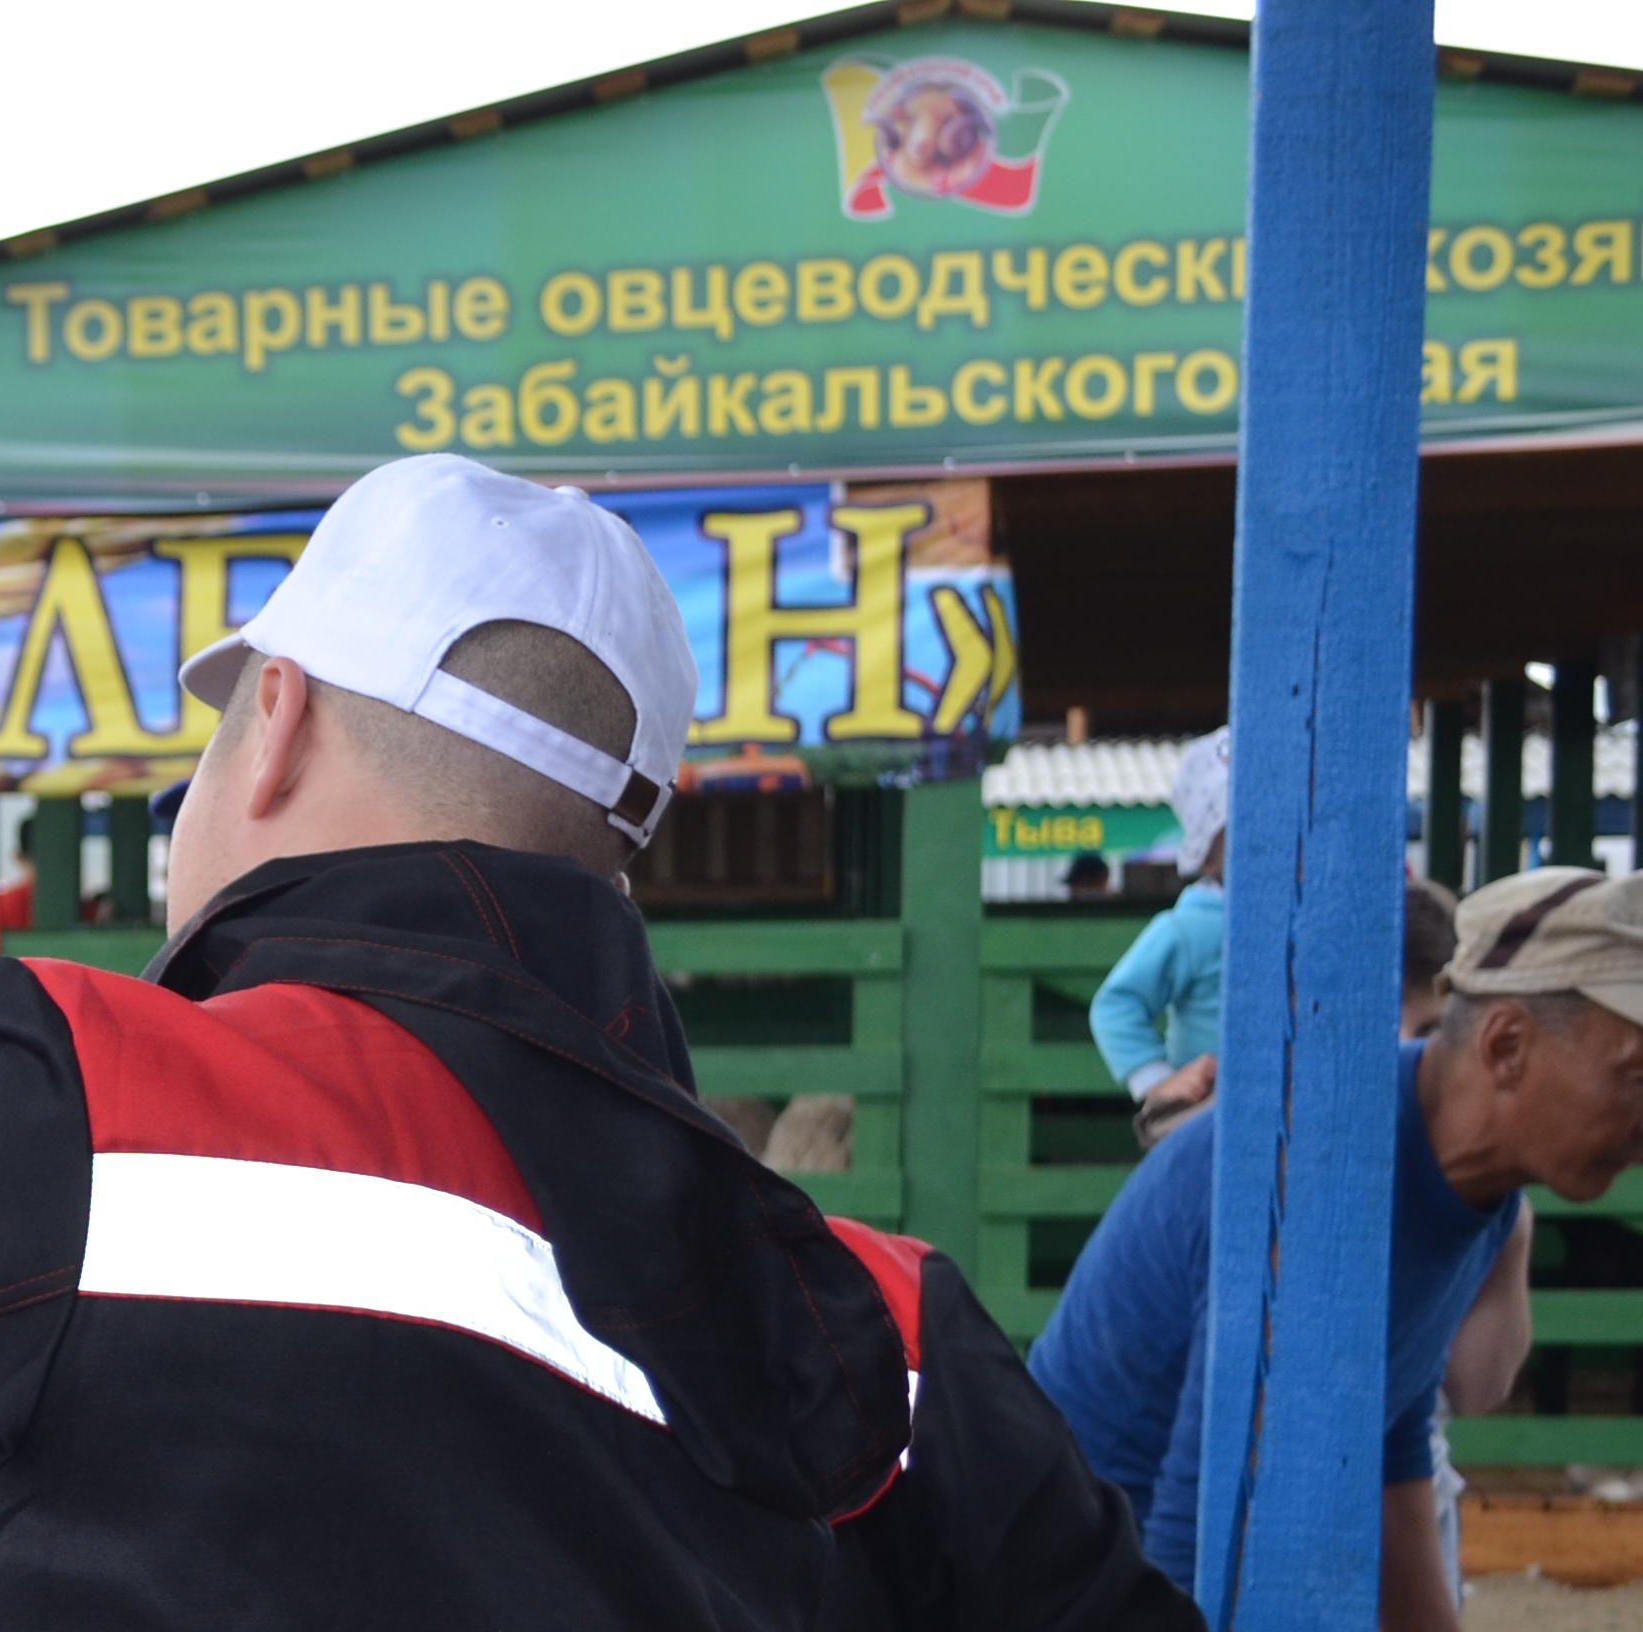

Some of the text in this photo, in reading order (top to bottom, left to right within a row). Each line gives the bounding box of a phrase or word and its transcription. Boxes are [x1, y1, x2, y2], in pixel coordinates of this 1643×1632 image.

[6, 277, 510, 371] Товарные
[539, 237, 1246, 341] овцеводческ
[396, 350, 1240, 451] Забайкальского
[990, 808, 1105, 848] Тыва
